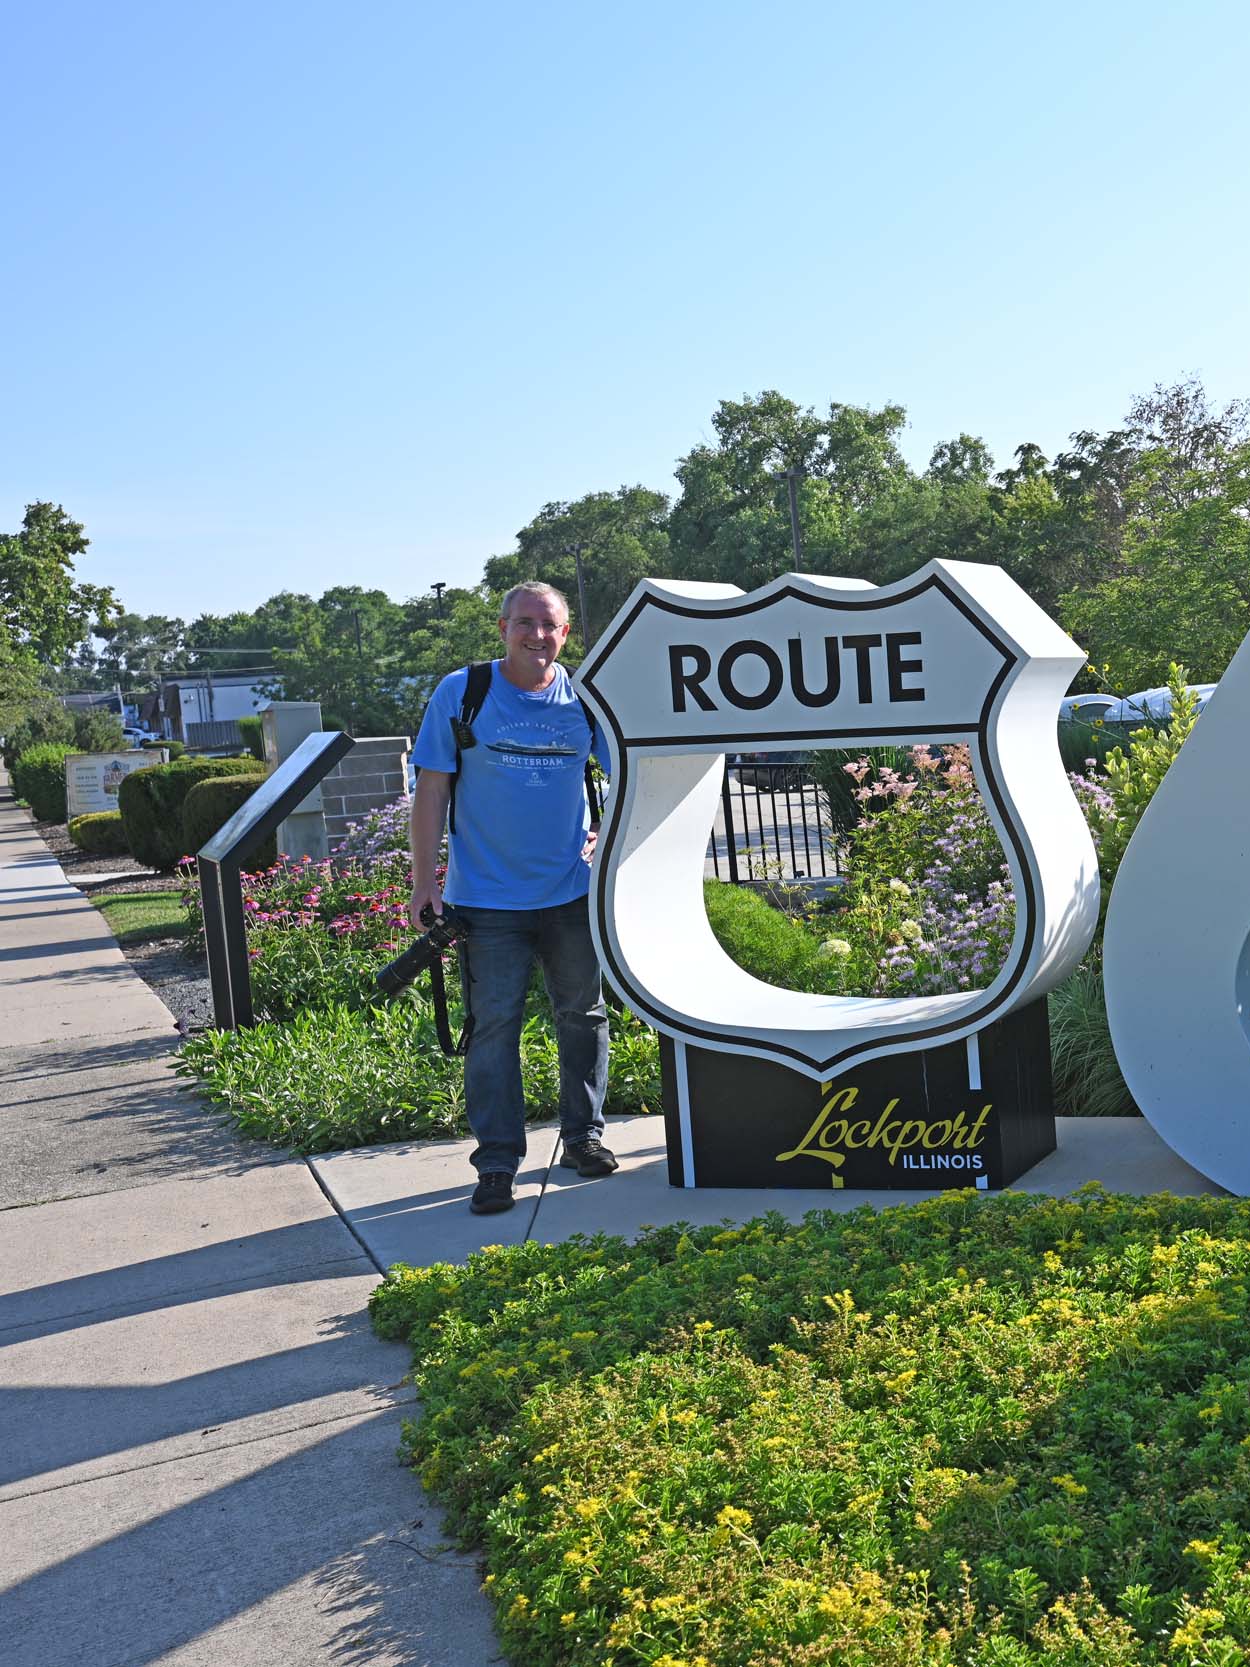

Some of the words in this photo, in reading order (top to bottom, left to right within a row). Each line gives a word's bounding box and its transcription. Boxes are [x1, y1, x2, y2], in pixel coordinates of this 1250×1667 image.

[668, 632, 925, 712] ROUTE
[502, 755, 564, 766] ROTTERDAM
[775, 1087, 993, 1168] Lockport
[903, 1154, 983, 1169] ILLINOIS
